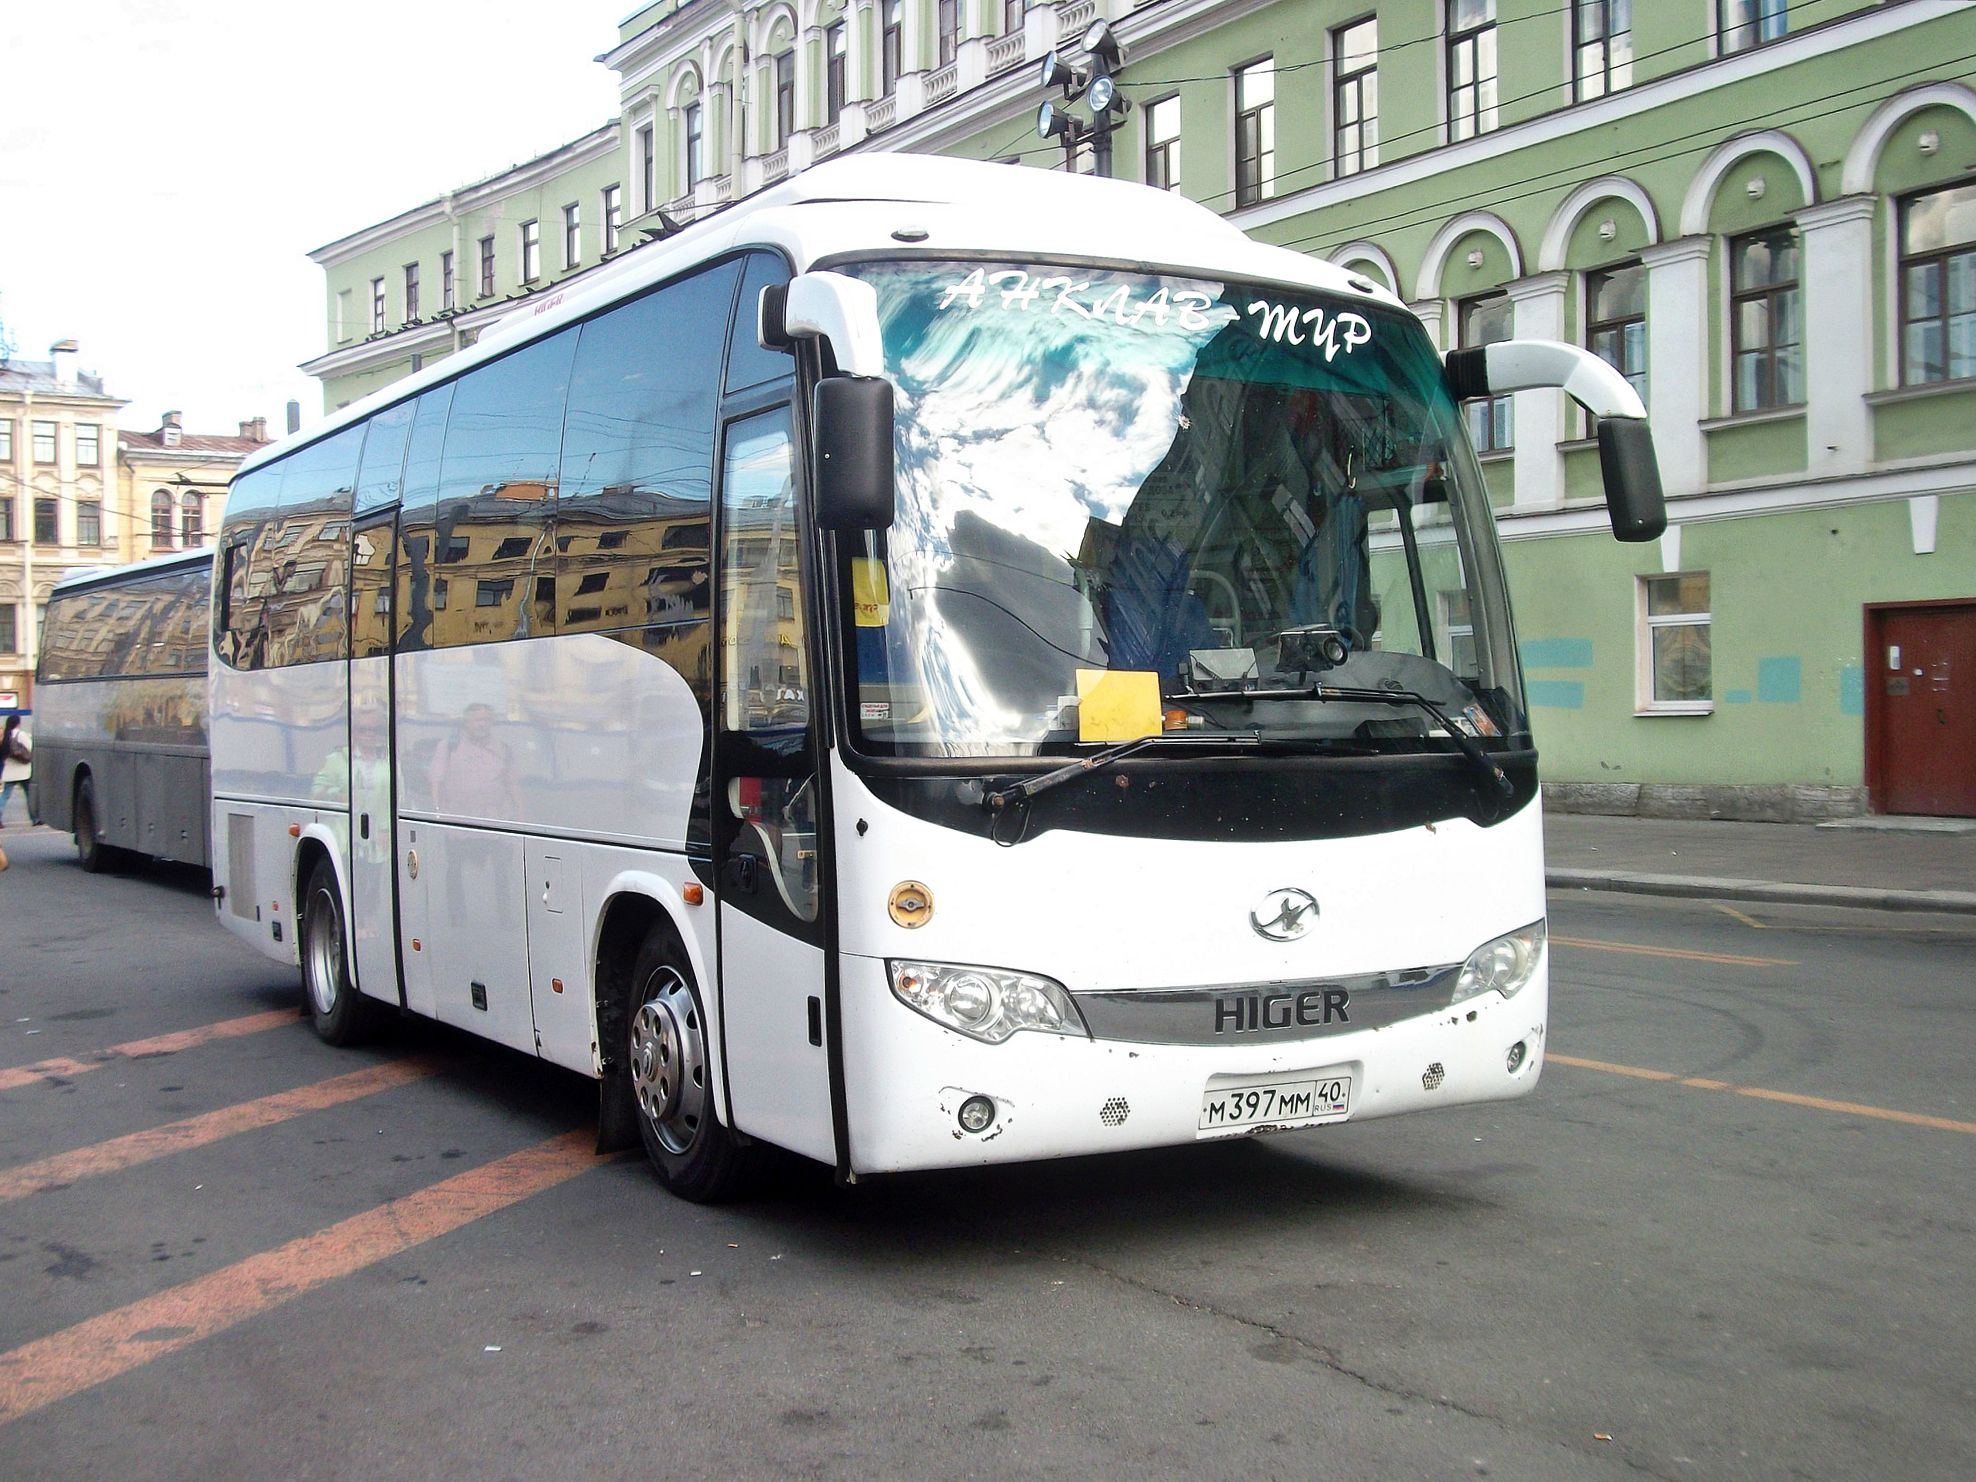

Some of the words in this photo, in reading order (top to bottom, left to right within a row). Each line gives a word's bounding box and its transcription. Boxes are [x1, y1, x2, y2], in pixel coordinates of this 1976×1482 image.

[1214, 989, 1352, 1036] HIGER
[1208, 1089, 1312, 1124] М397ММ
[1317, 1081, 1341, 1104] 40
[1314, 1103, 1332, 1113] RUS
